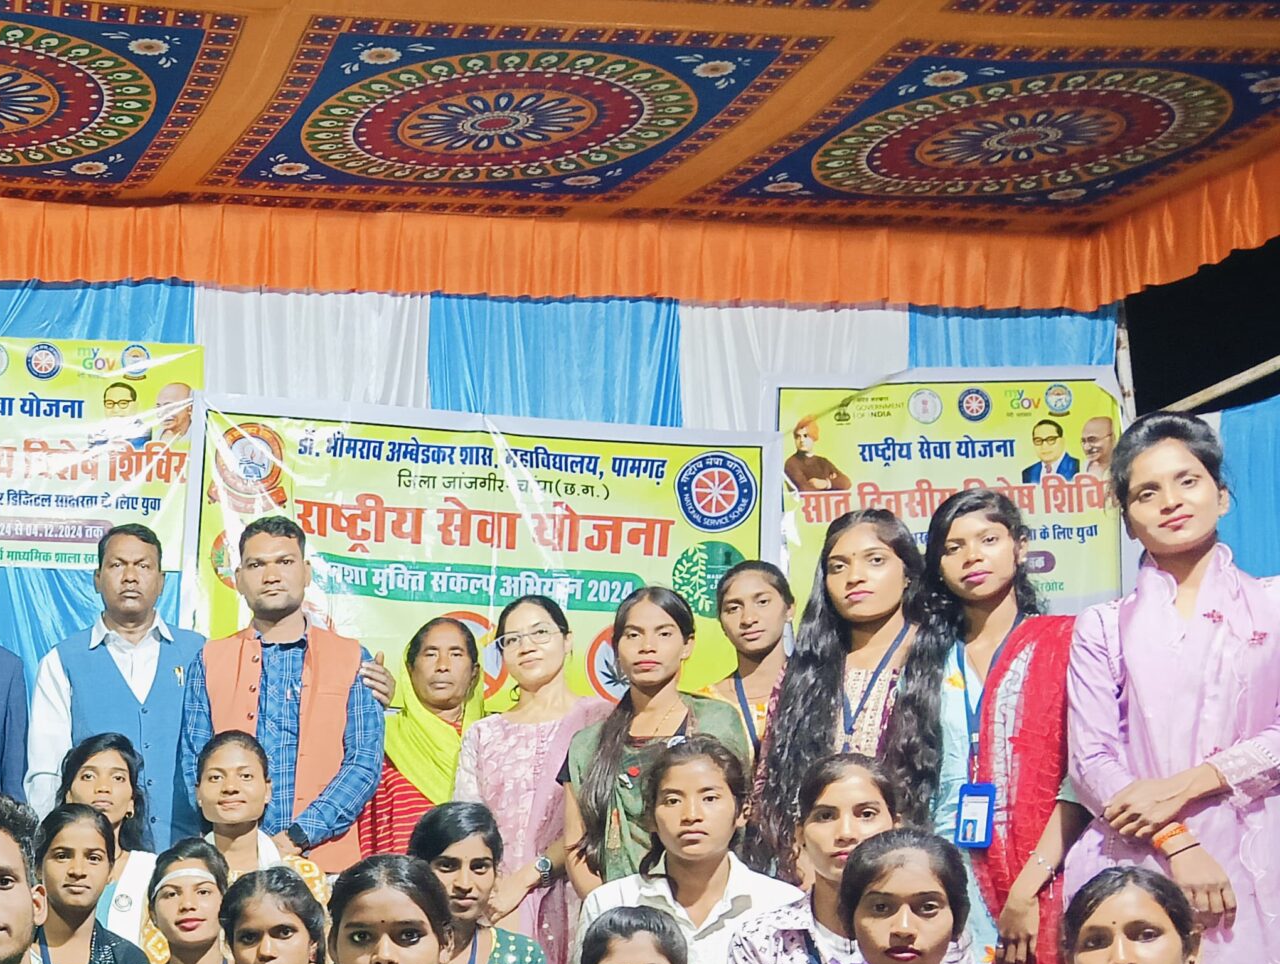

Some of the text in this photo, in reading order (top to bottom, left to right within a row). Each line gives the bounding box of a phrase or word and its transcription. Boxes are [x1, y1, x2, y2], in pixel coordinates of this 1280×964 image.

[82, 357, 117, 372] GOV
[19, 391, 85, 419] योजना
[1010, 398, 1041, 410] GOV
[107, 442, 188, 484] शिविर
[327, 431, 384, 461] भीमराव
[386, 437, 457, 465] अम्बेडकर
[460, 446, 498, 469] शास.
[611, 456, 668, 486] पामगढ़
[858, 434, 1016, 468] राष्ट्रीय सेवा योजना
[398, 469, 437, 489] जिला
[141, 496, 162, 516] युवा
[683, 493, 749, 526] NATIONAL SERVICE SCHEME
[294, 493, 676, 558] राष्ट्रीय सेवा योजना
[1052, 525, 1074, 542] लिए
[1076, 524, 1099, 544] युवा
[431, 566, 496, 597] संकल्प
[587, 579, 634, 603] 2024
